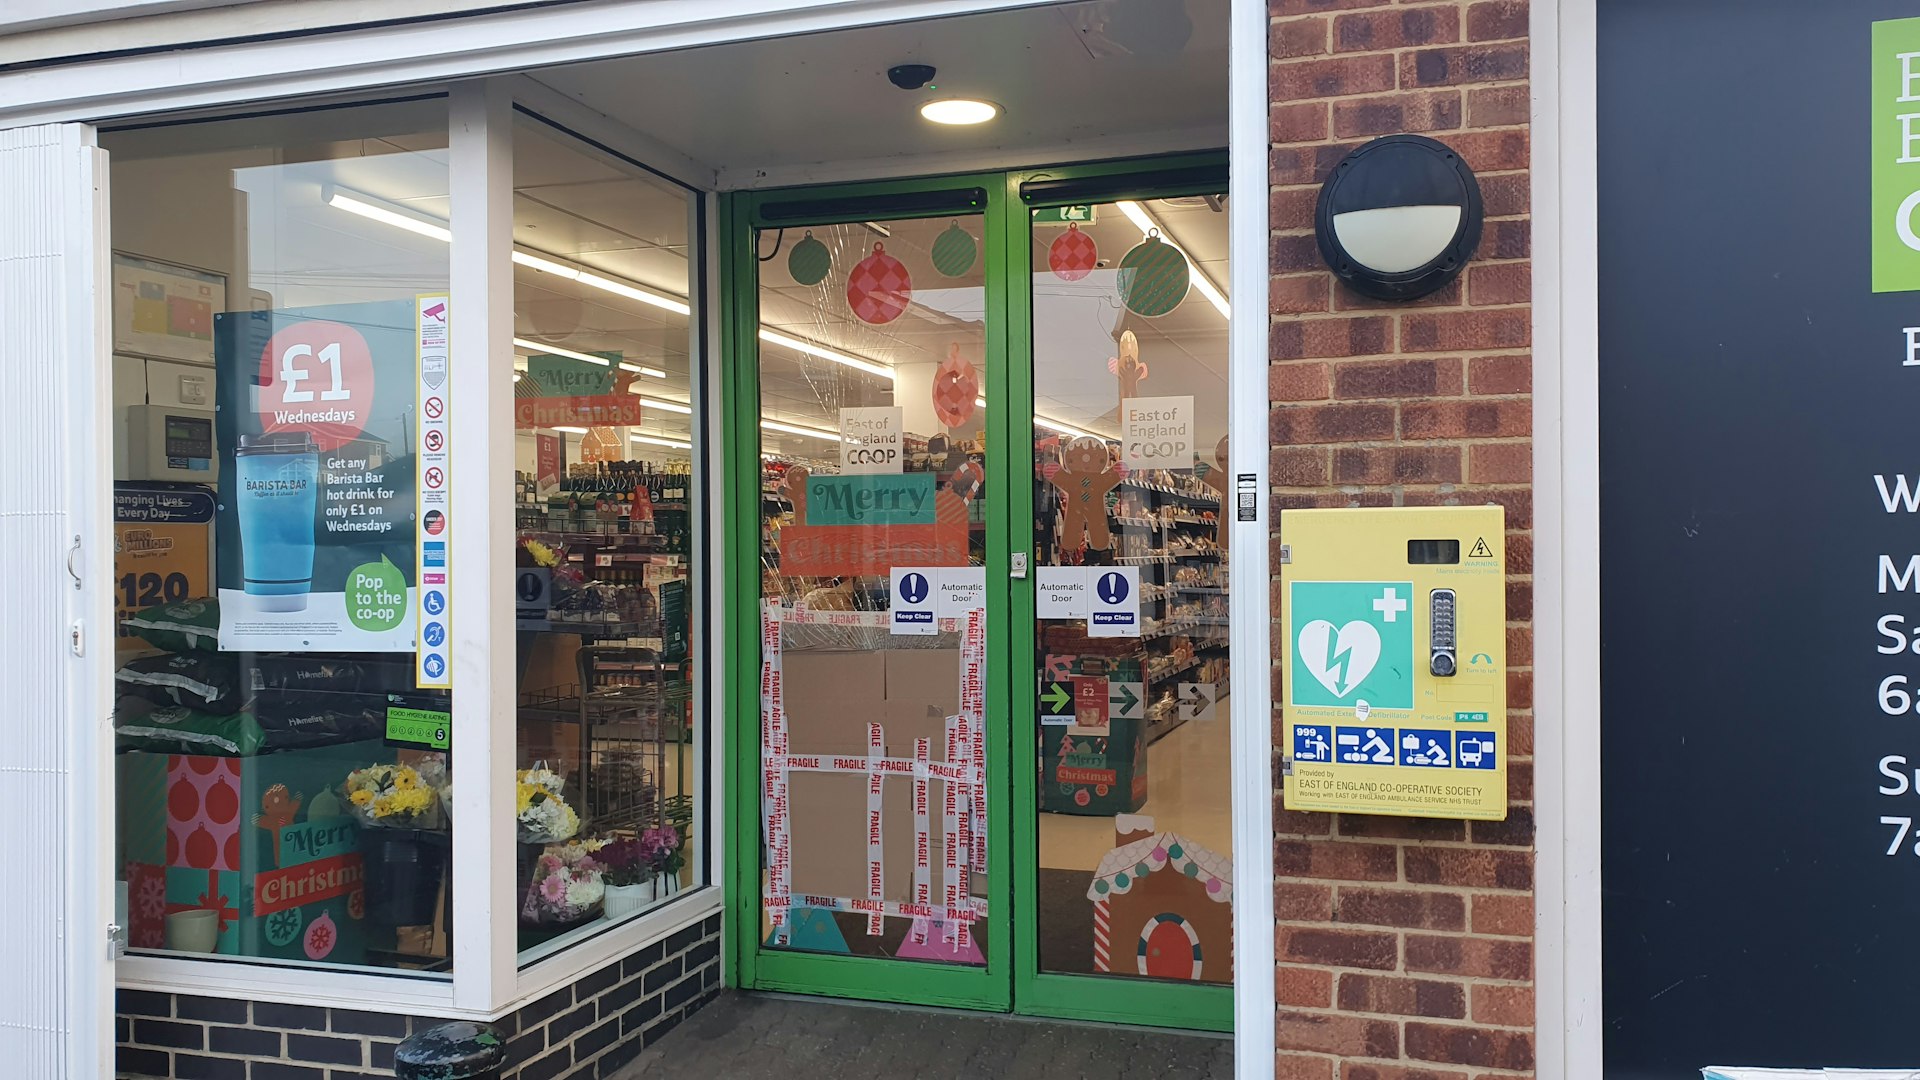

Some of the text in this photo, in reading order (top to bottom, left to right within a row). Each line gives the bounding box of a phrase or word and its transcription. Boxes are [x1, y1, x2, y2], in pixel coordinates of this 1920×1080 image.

[280, 343, 351, 403] £1
[540, 369, 606, 391] Merry
[275, 408, 356, 424] Wednesdays
[518, 403, 635, 425] Christmas
[876, 417, 889, 429] of
[1130, 408, 1177, 422] East of
[1130, 423, 1186, 439] England
[327, 458, 366, 471] Get any
[246, 479, 307, 491] BARISTA BAR
[327, 472, 384, 485] Barista Bar
[156, 495, 183, 505] Lives
[326, 488, 394, 500] hot drink for
[812, 482, 928, 520] Merry
[117, 507, 171, 520] Every Day
[326, 504, 383, 517] only £1 on
[326, 520, 392, 532] Wednesdays
[356, 574, 383, 592] Pop
[941, 583, 983, 591] Automatic
[1040, 583, 1084, 591] Automatic
[356, 590, 402, 604] to the
[952, 594, 972, 602] Door
[1051, 594, 1073, 602] Door
[356, 606, 395, 622] co-op
[1094, 613, 1132, 622] Keep Clear
[968, 611, 978, 647] FRAGILE
[772, 670, 780, 705] FRAGILE
[1083, 688, 1094, 696] £2
[1878, 674, 1920, 716] 6
[288, 714, 323, 727] Homefire
[772, 706, 780, 731] AGILE
[1297, 709, 1335, 717] Automated
[1368, 711, 1410, 719] Defibrillator
[871, 722, 881, 747] AGILE
[958, 715, 968, 743] AGILE
[1296, 727, 1316, 737] 999
[917, 738, 927, 764] AGILE
[973, 732, 983, 768] FRAGILE
[1067, 753, 1104, 766] Merry
[788, 757, 961, 779] FRAGILE FRAGILE FRAGILE FRAGILE
[1058, 768, 1113, 782] Christmas
[1300, 769, 1334, 779] Provided by
[1878, 755, 1920, 796] S
[766, 769, 774, 799] RAGILE
[1300, 779, 1483, 796] EAST OF ENGLAND CO-OPERATIVE SOCIETY
[917, 780, 926, 816] FRAGILE
[947, 780, 956, 816] FRAGILE
[974, 784, 985, 819] FRAGILE
[1299, 790, 1320, 798] Working
[1387, 794, 1422, 803] AMBULANCE
[1424, 796, 1447, 804] SERVICE
[870, 810, 880, 845] FRAGILE
[959, 812, 968, 848] FRAGILE
[918, 831, 927, 868] FRAGILE
[947, 832, 956, 868] FRAGILE
[975, 836, 985, 872] FRAGILE
[261, 863, 364, 904] Christm
[871, 861, 881, 896] FRAGILE
[959, 864, 968, 900] FRAGILE
[918, 883, 927, 905] FRAG
[947, 885, 956, 907] FRAG
[764, 896, 975, 920] RAGILE FRAGILE FRAGILE FRAGILE FRAGIL
